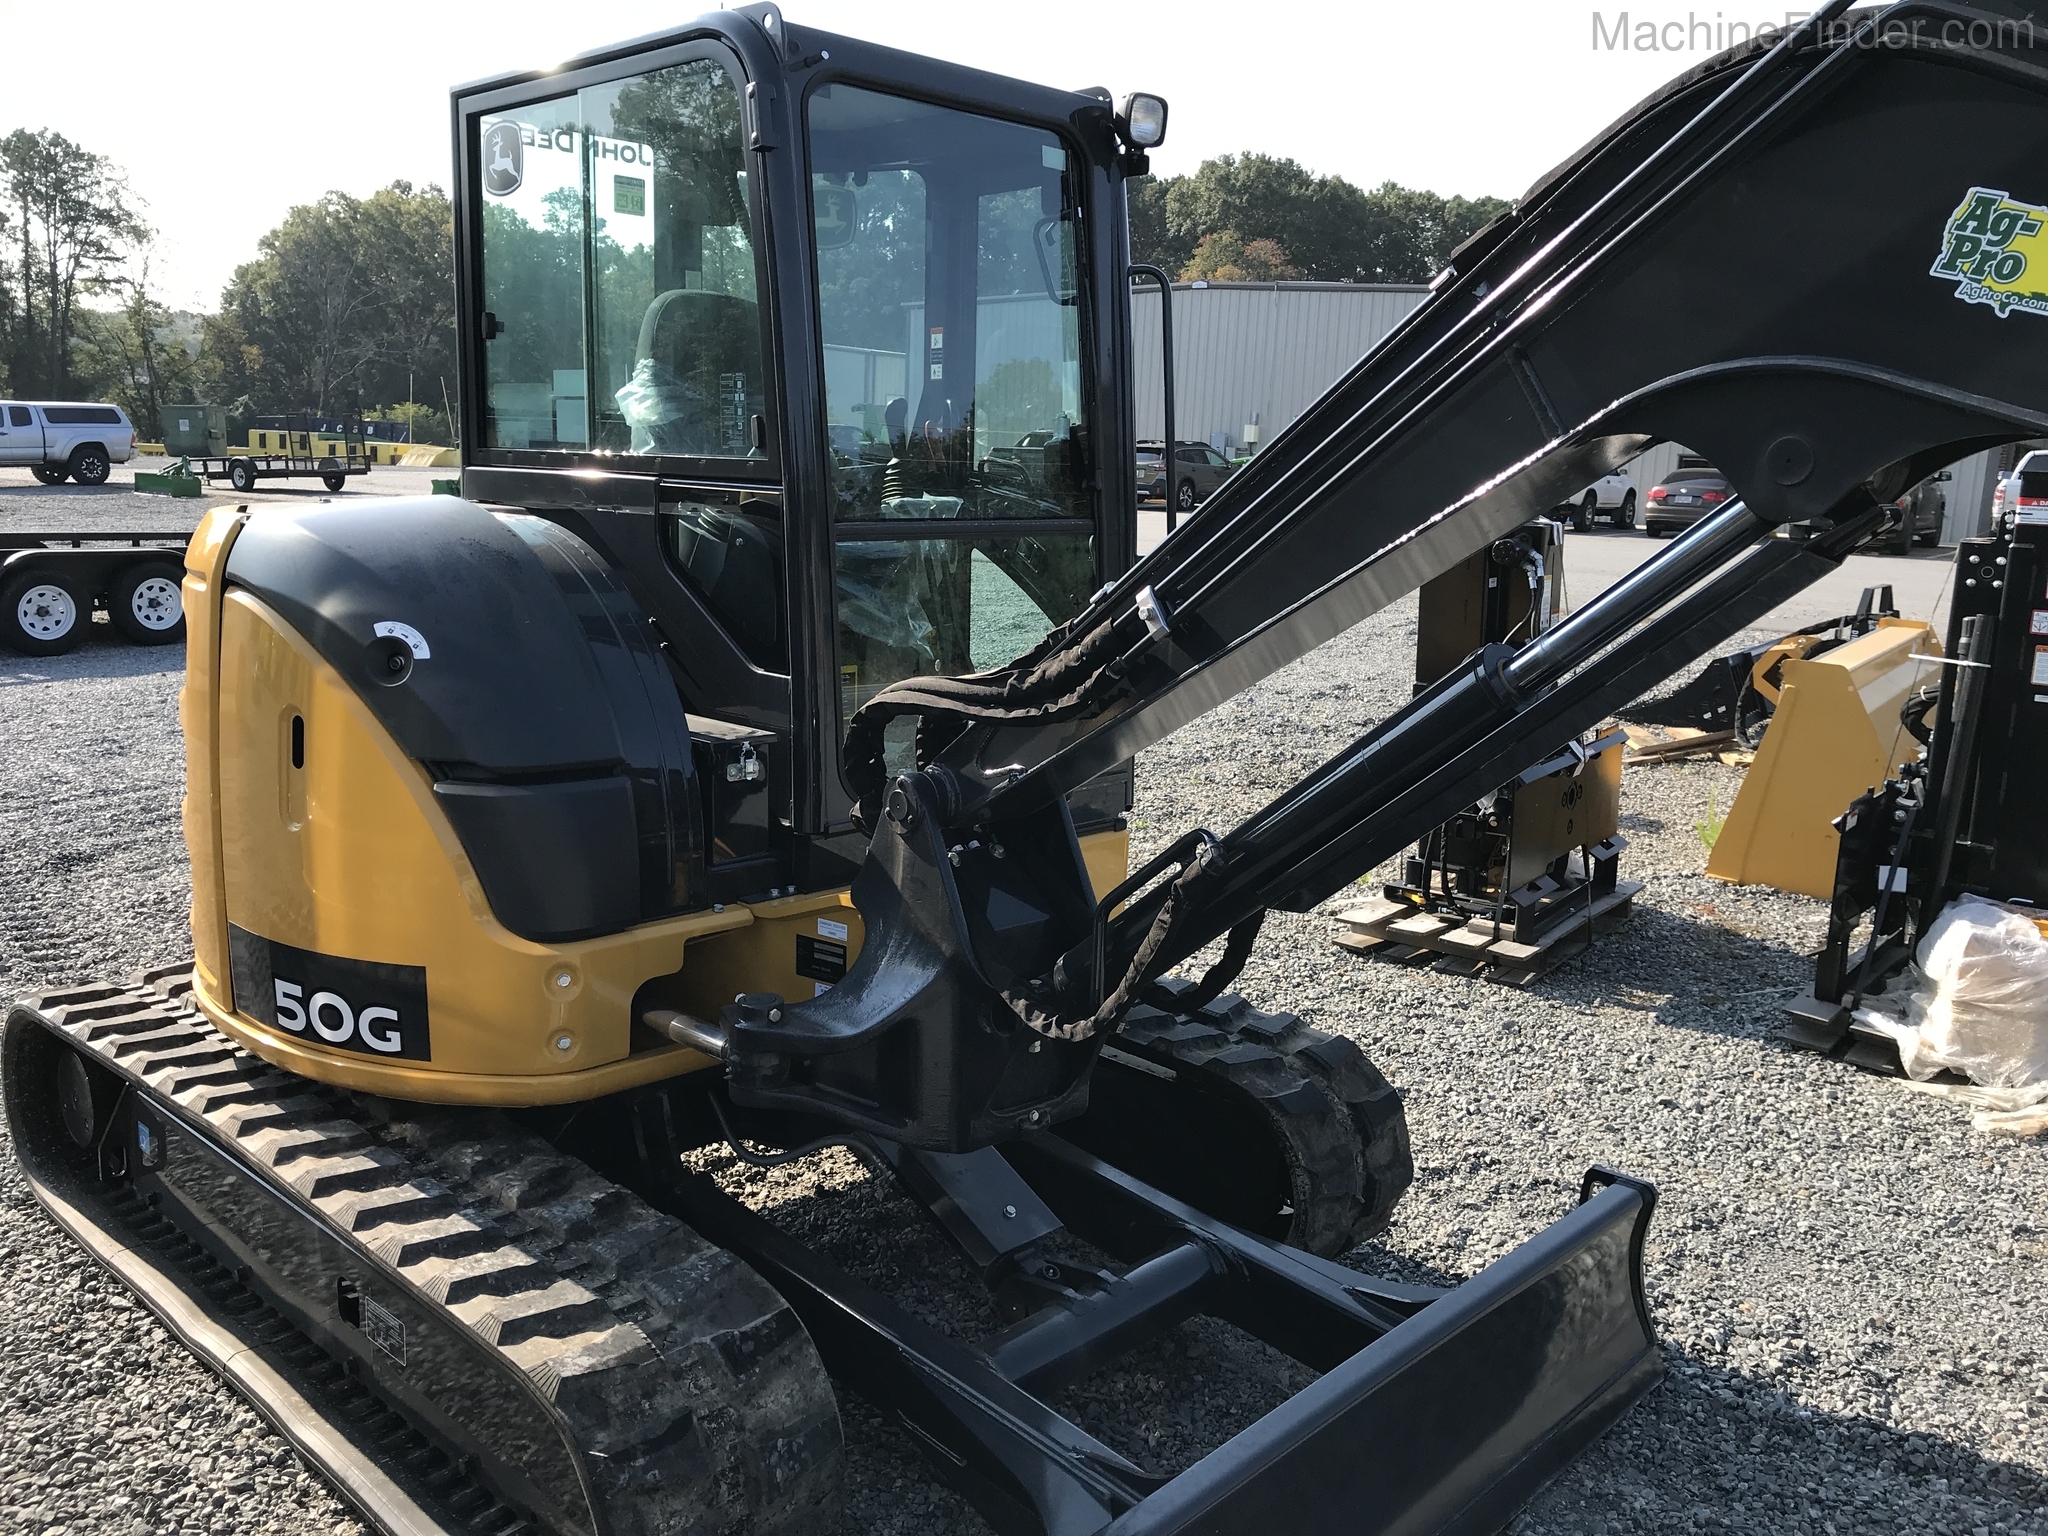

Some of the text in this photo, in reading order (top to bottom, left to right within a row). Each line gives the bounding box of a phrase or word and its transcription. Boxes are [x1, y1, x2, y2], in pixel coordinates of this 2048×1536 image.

[1951, 192, 2041, 250] Ag-
[1936, 233, 2026, 283] Pro
[1961, 284, 2048, 311] AgProCo.com
[274, 977, 402, 1053] 50G
